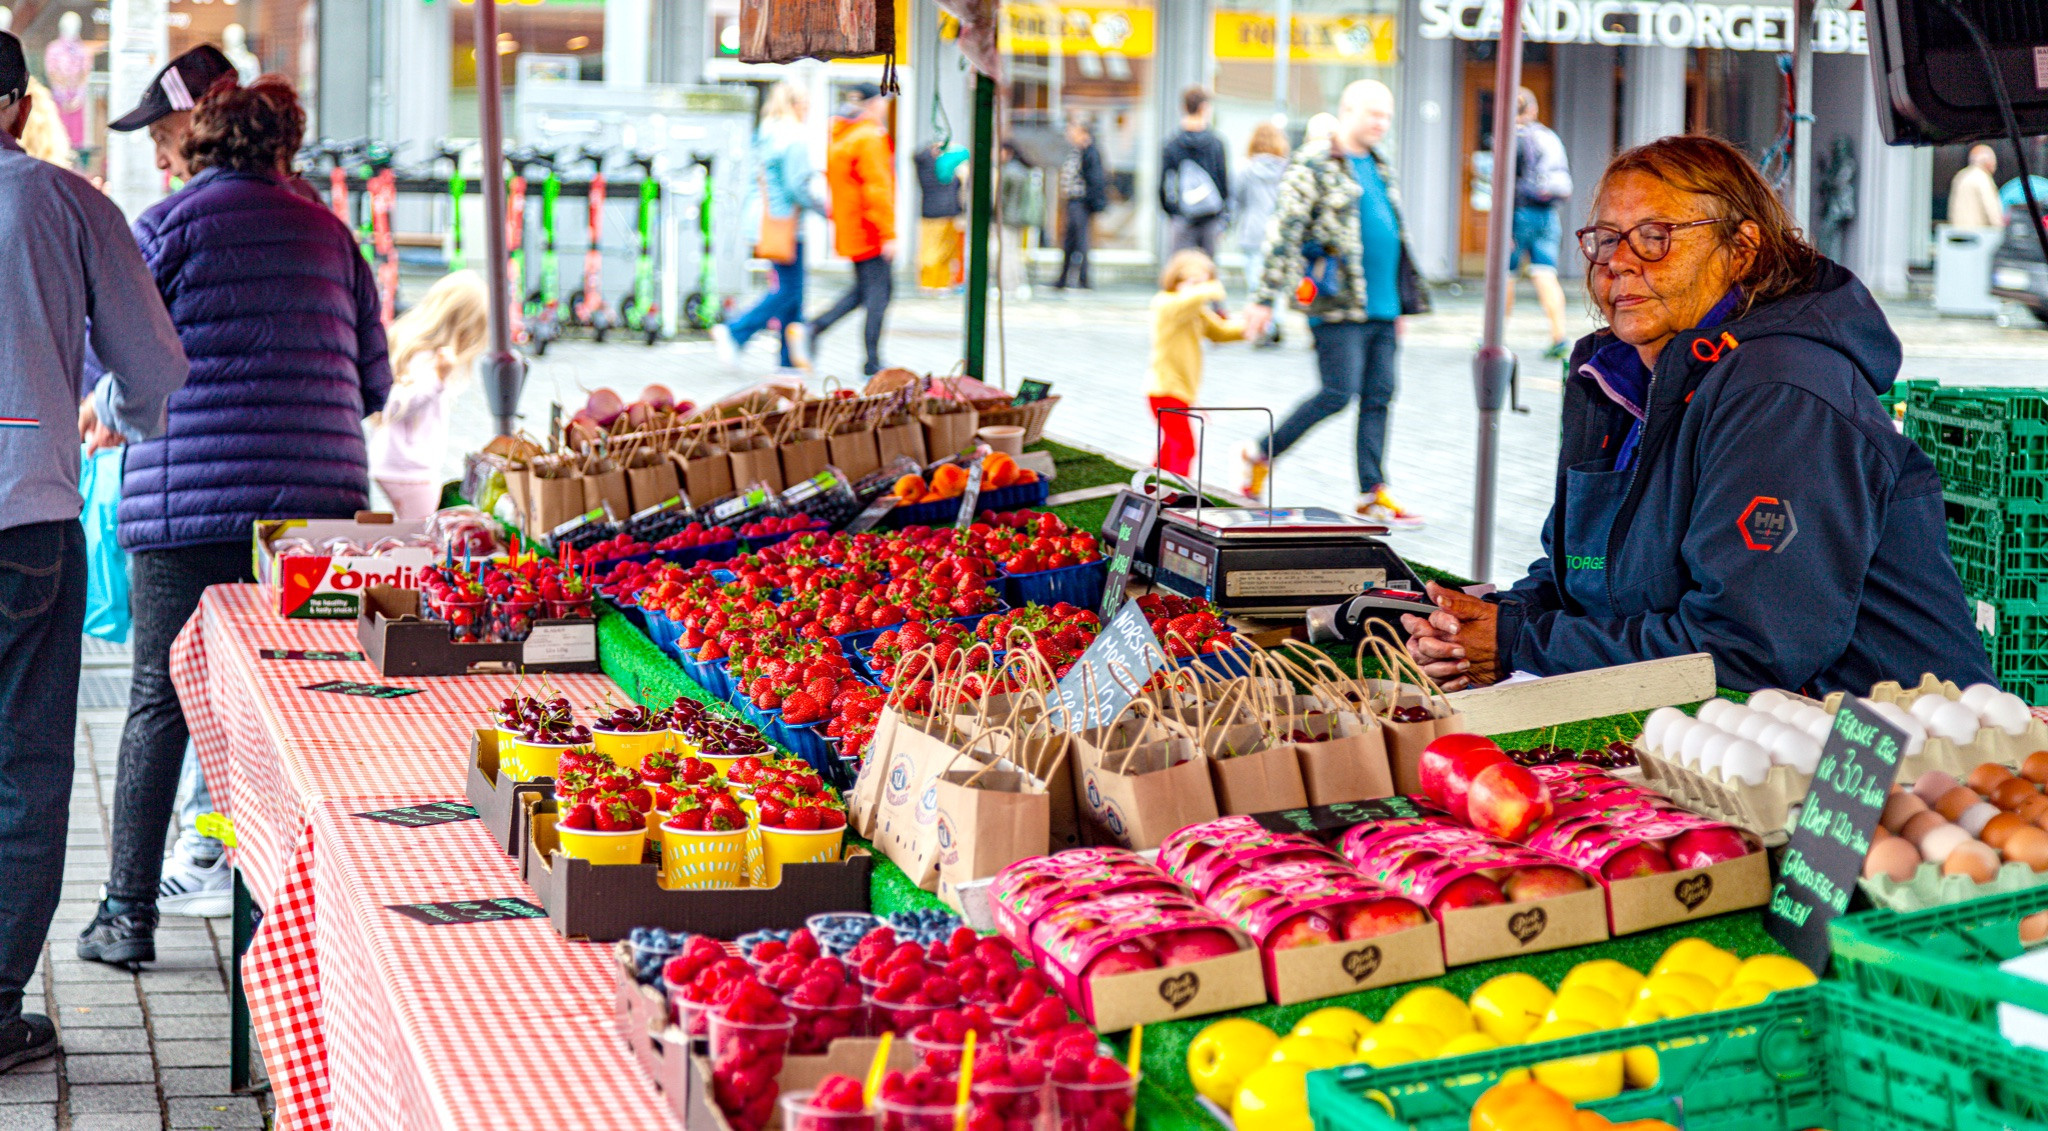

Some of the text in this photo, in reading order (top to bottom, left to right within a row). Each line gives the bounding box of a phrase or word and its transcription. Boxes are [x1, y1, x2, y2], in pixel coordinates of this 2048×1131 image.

[1418, 0, 1622, 45] SCANDIC
[1624, 2, 1795, 52] TORGET
[1754, 511, 1786, 530] HH
[1112, 610, 1158, 667] NORSKE
[1833, 707, 1899, 766] FERSKE EGG
[1816, 754, 1837, 782] KR
[1769, 882, 1813, 928] GULEN
